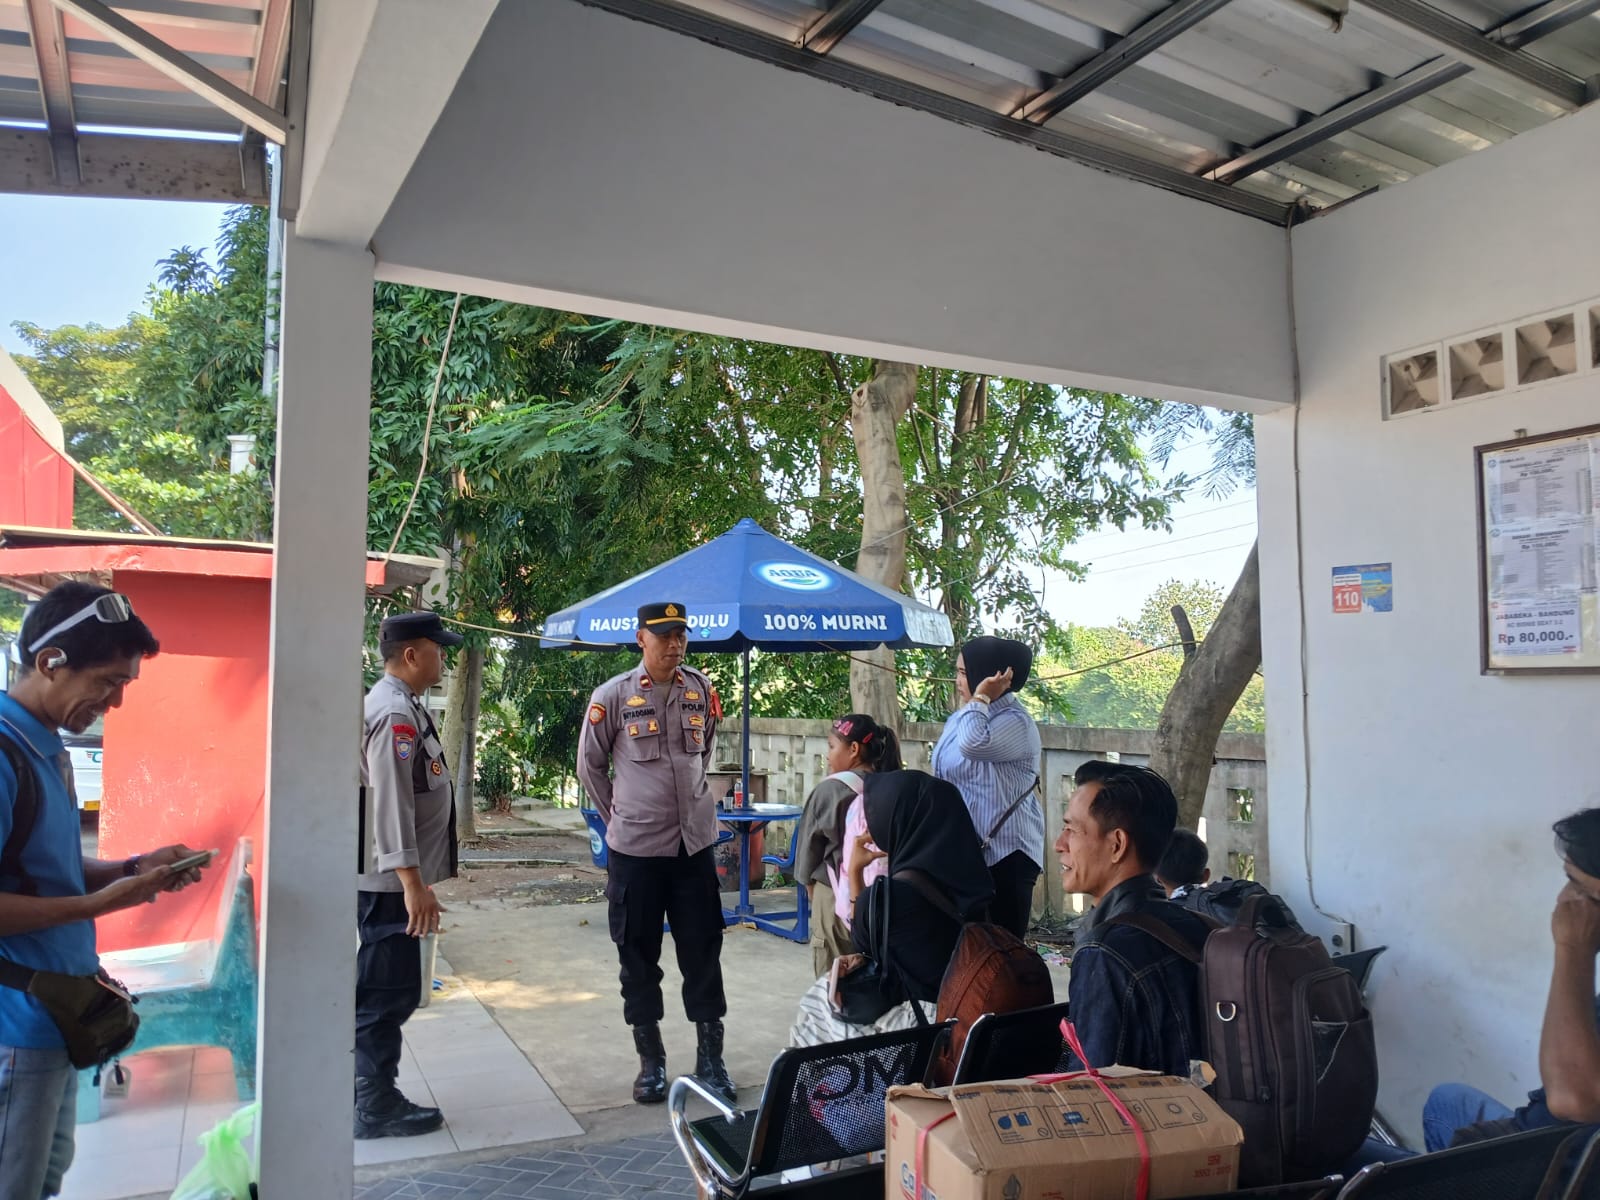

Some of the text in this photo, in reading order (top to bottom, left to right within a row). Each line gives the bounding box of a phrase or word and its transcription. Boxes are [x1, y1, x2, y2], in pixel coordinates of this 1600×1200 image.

[768, 568, 818, 578] AQUA
[1335, 591, 1359, 607] 110
[1538, 609, 1575, 618] BANDUNG
[589, 617, 638, 632] HAUS?
[687, 614, 729, 628] DULU
[764, 614, 888, 631] 100% MURNI
[1498, 633, 1515, 645] Rp
